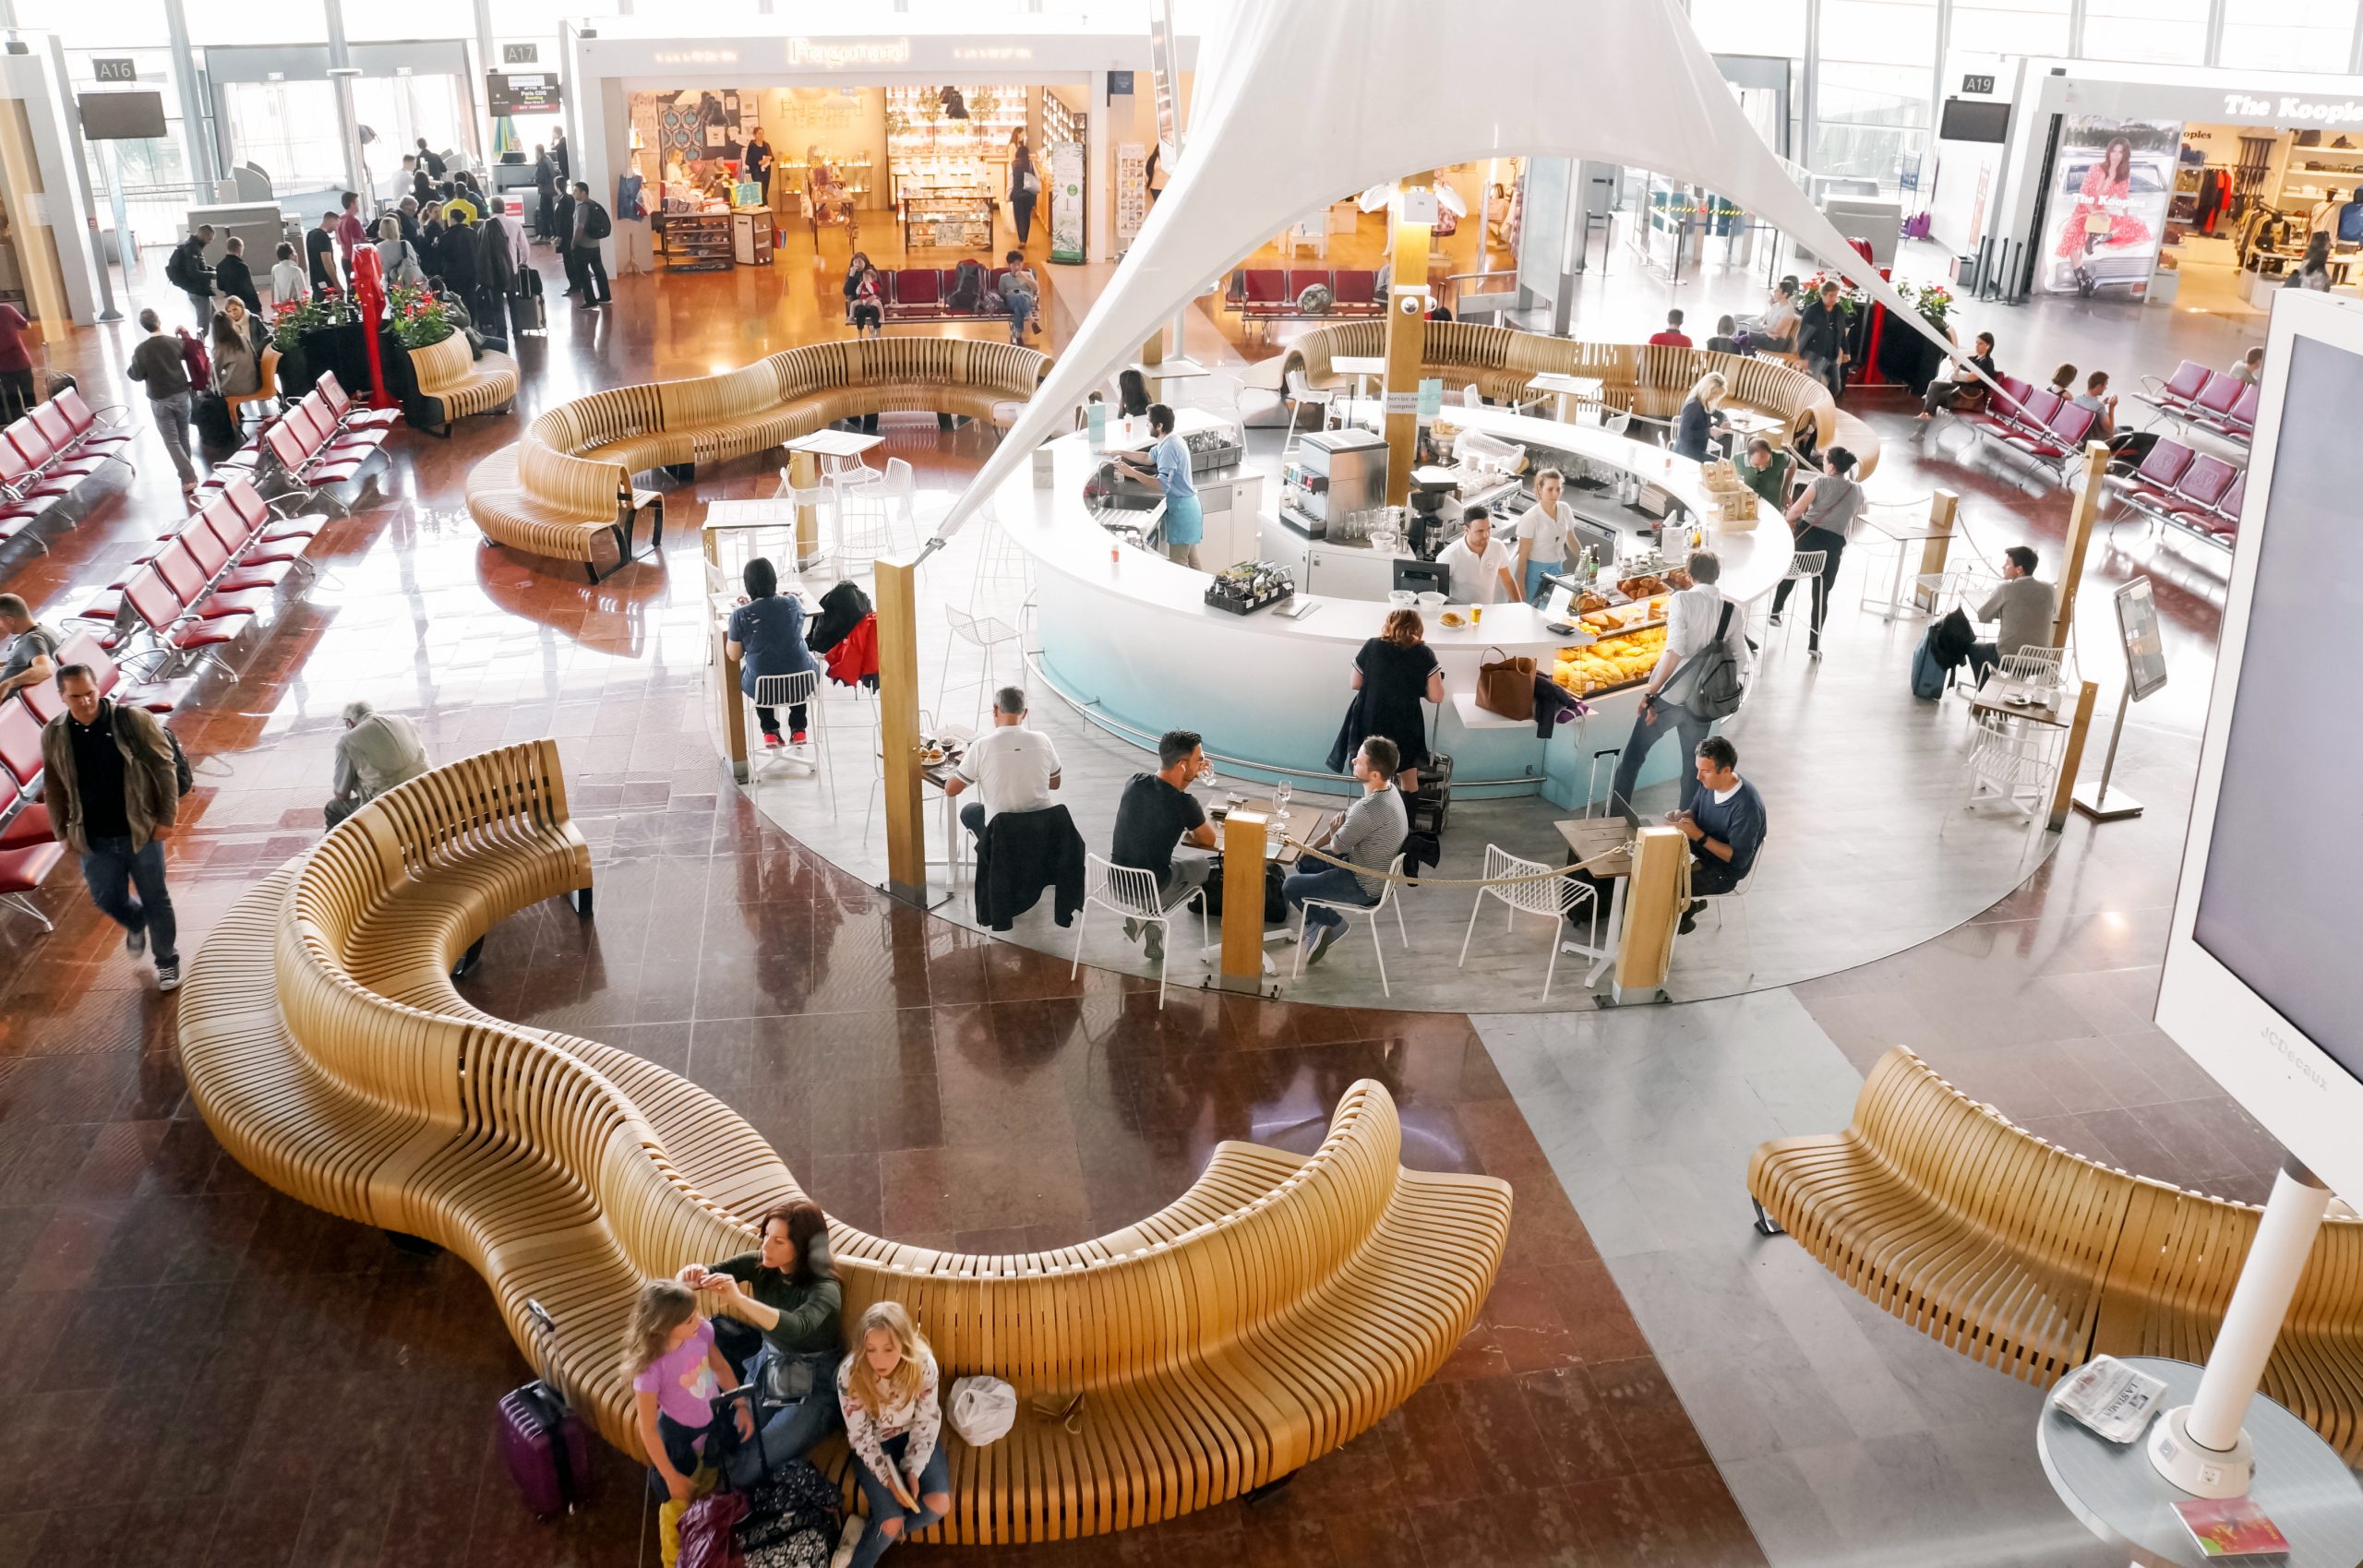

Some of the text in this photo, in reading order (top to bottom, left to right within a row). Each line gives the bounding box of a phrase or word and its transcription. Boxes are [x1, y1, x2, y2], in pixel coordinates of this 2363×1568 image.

[508, 46, 533, 61] A17
[789, 38, 908, 67] Fragonard
[100, 63, 131, 78] A16
[1965, 78, 1991, 91] A19
[2225, 95, 2271, 115] The
[2071, 194, 2146, 209] The Kooples
[2260, 1025, 2328, 1093] JCDecaux
